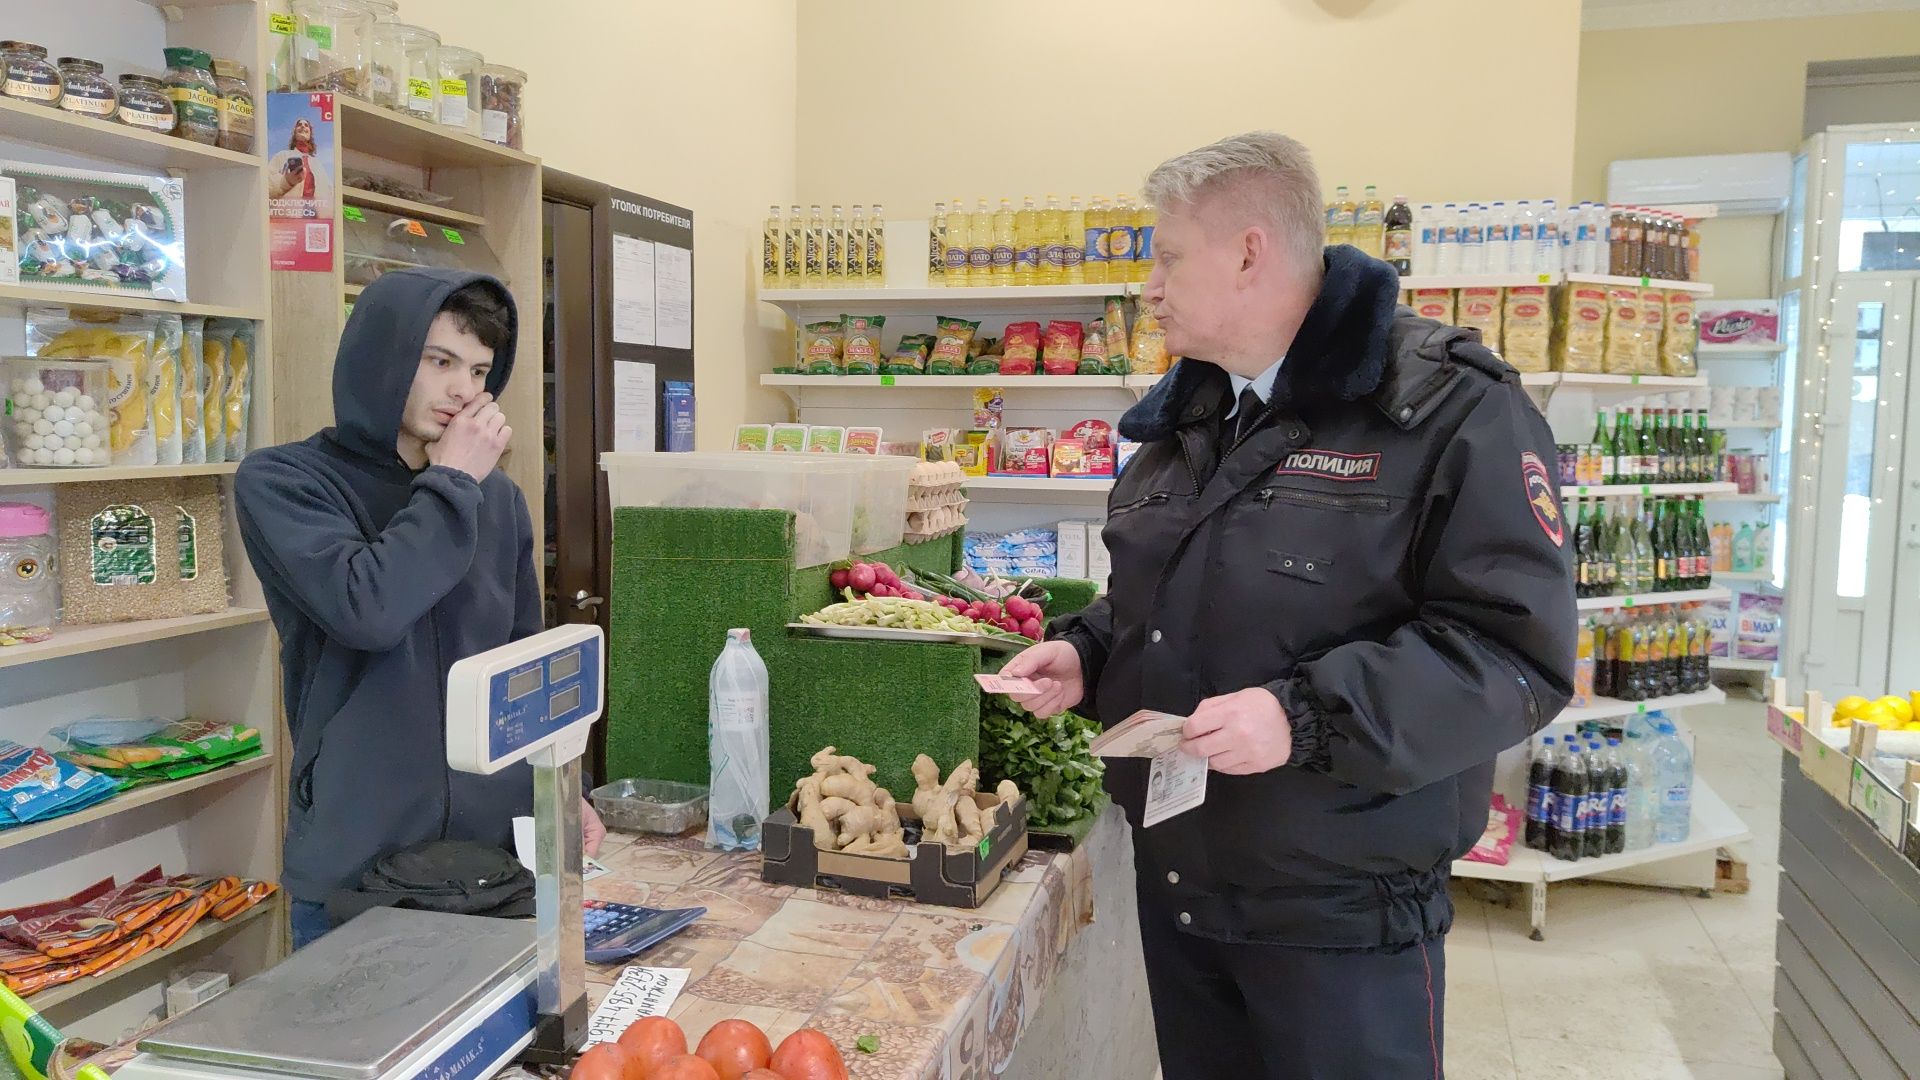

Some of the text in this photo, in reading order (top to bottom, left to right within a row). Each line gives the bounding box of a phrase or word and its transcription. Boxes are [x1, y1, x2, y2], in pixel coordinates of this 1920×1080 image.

[5, 82, 52, 95] PLATINUM
[63, 96, 108, 109] PLATINUM
[188, 91, 218, 106] JACOBS
[227, 102, 254, 115] JACOBS
[286, 208, 316, 217] ЗДЕСЬ
[611, 198, 691, 230] УГОЛОК ПОТРЕБИТЕЛЯ
[1285, 454, 1374, 476] ПОЛИЦИЯ
